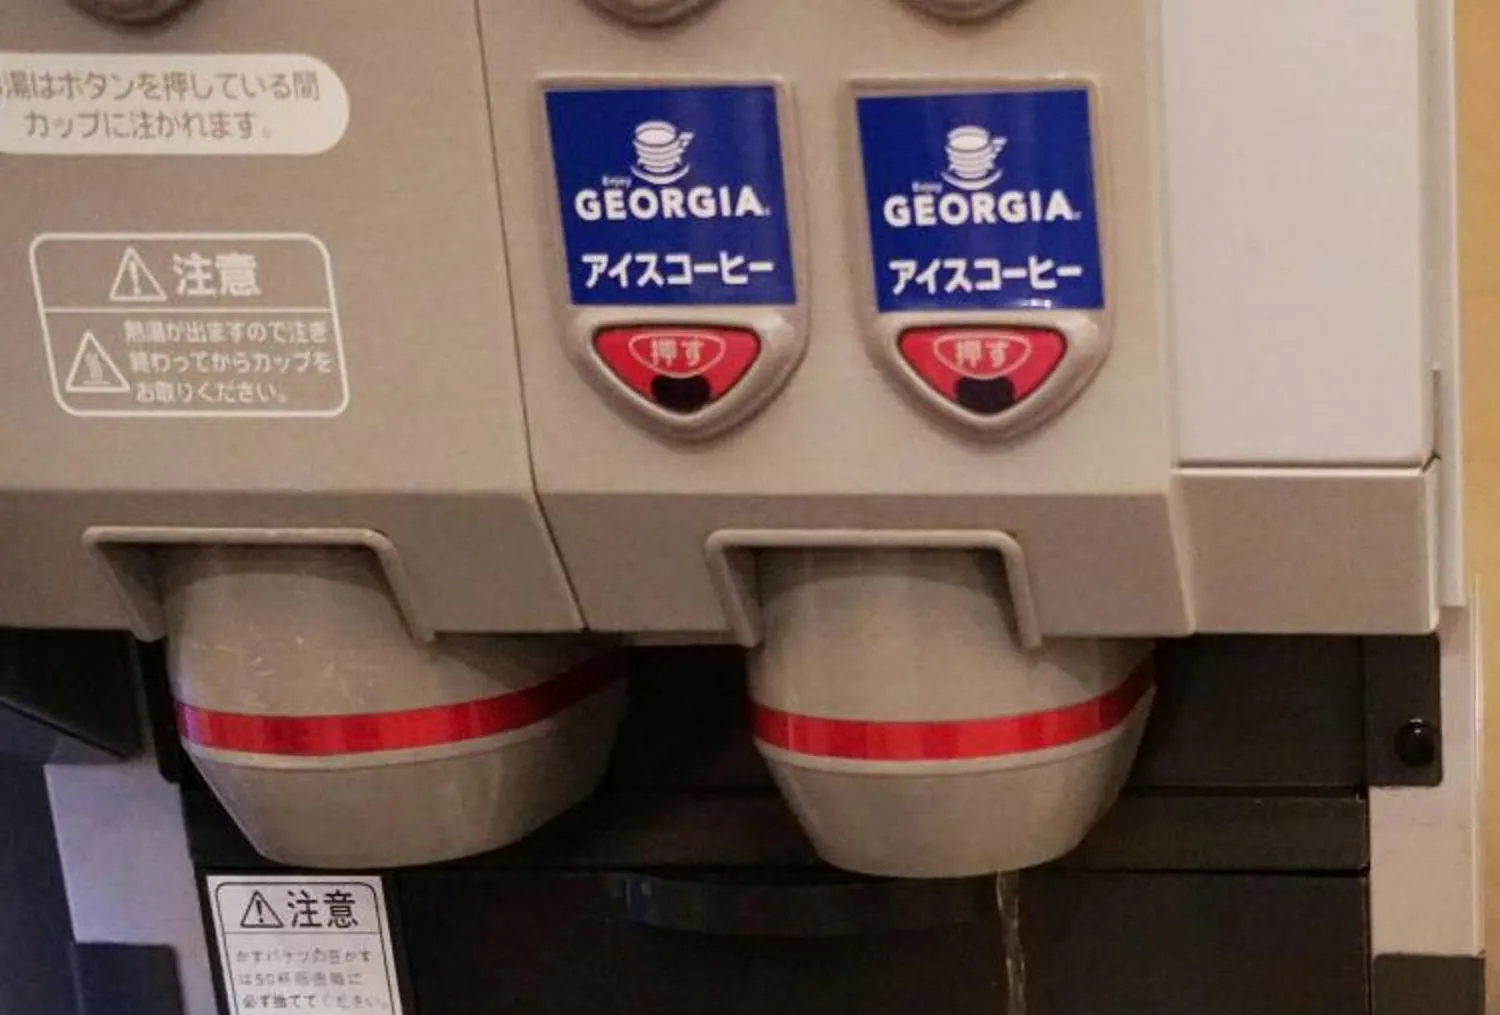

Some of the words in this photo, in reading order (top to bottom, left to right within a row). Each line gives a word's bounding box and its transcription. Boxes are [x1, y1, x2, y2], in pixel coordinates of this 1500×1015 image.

[0, 69, 320, 102] 湯はボタンを押している間
[24, 109, 273, 140] カップに注がれます。
[574, 185, 766, 221] GEORGIA
[883, 189, 1074, 227] GEORGIA
[172, 251, 263, 297] 注意
[580, 250, 775, 290] アイスコーヒー
[887, 254, 1084, 296] アイスコーヒー
[651, 336, 705, 368] 押す
[955, 338, 1011, 369] 押す
[286, 889, 359, 930] 注意
